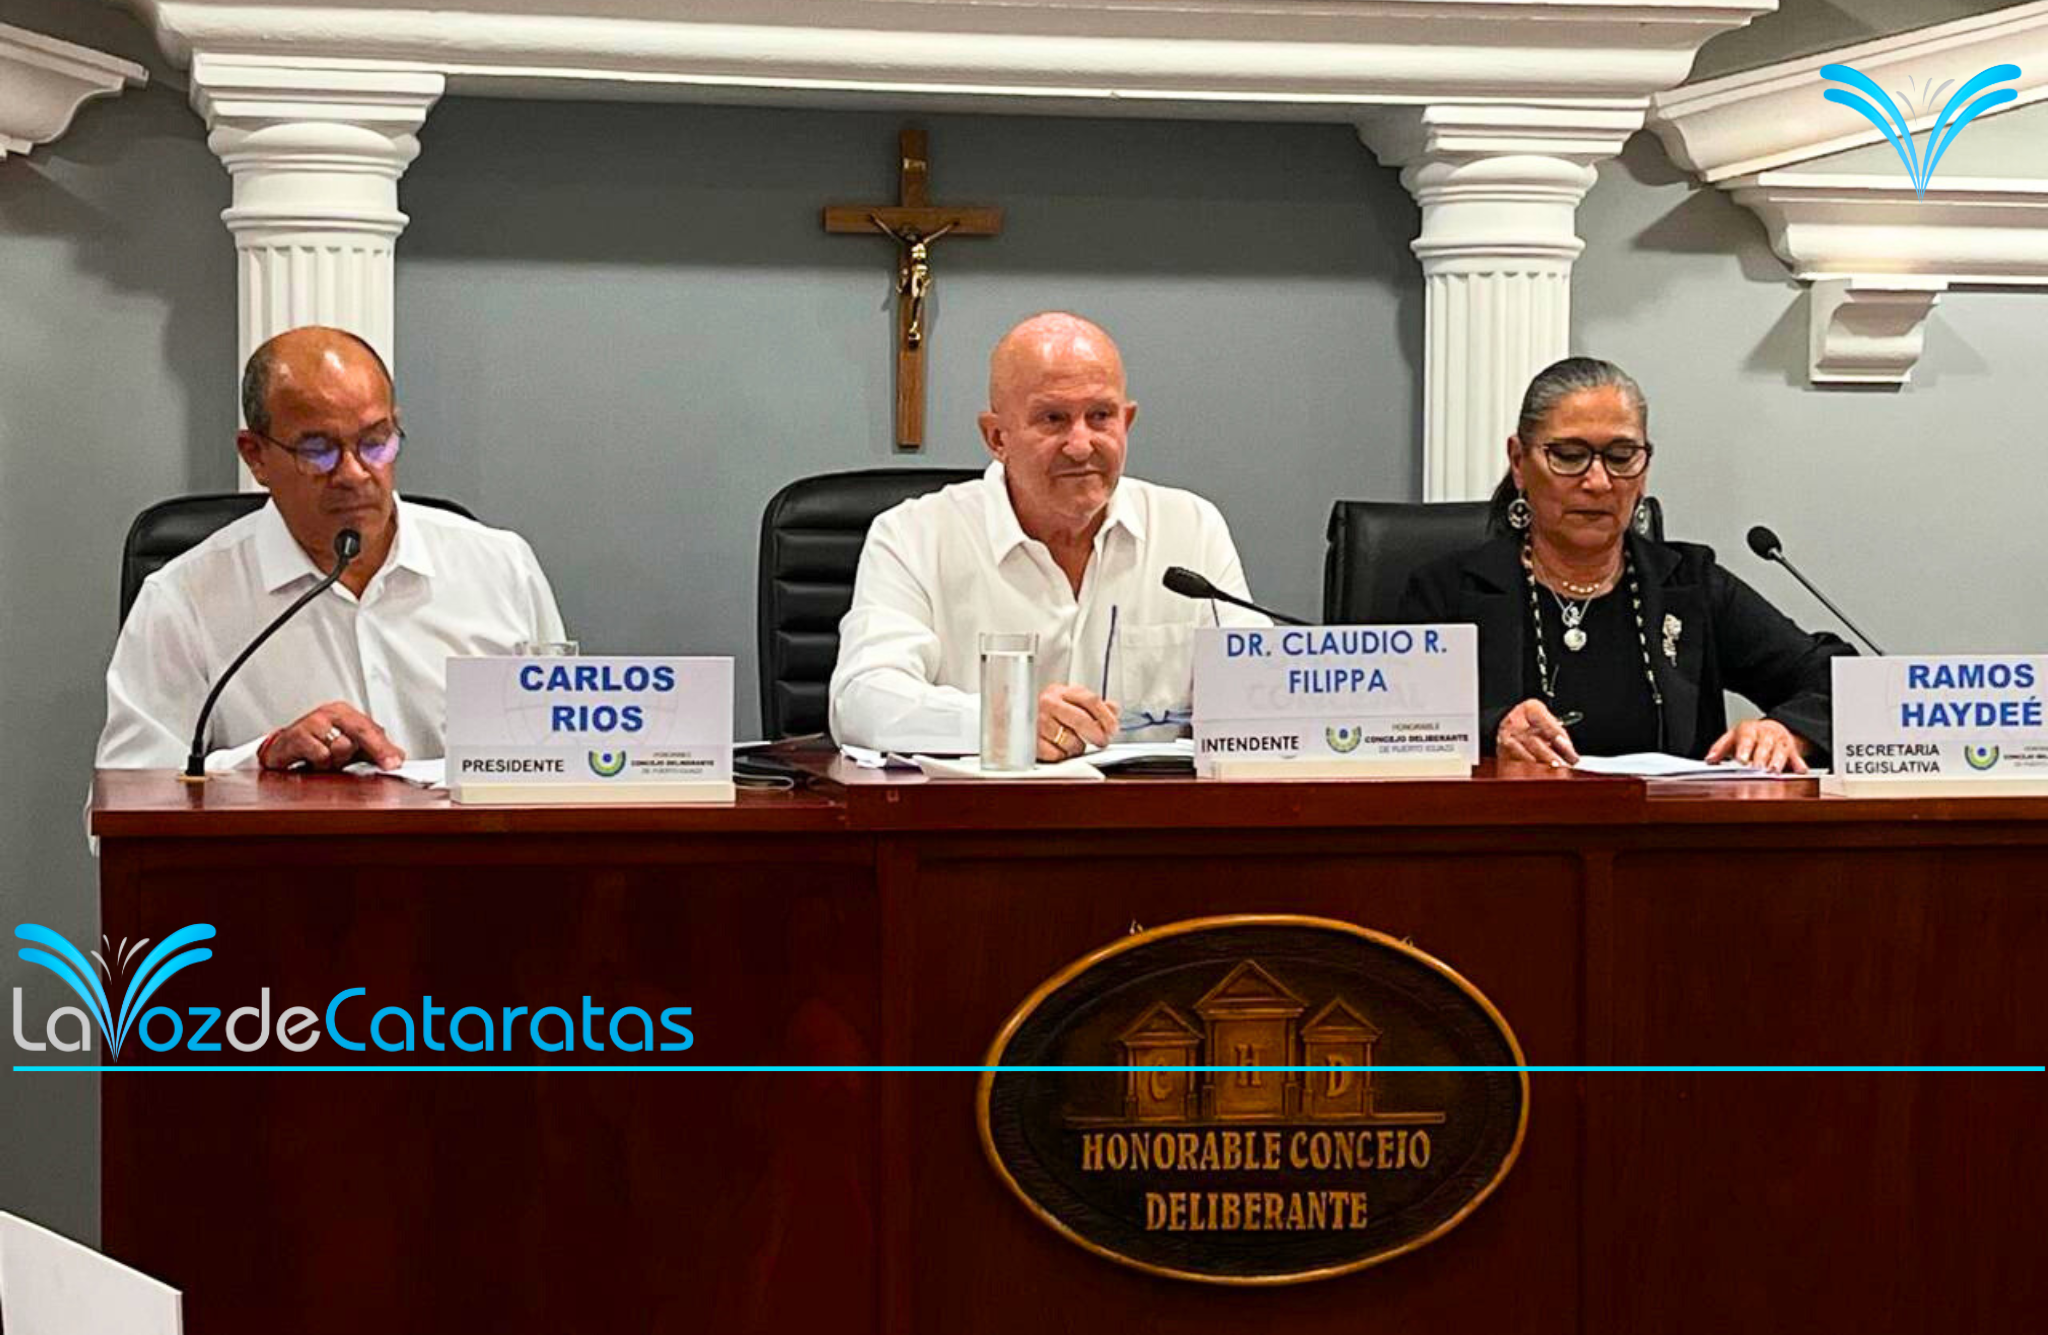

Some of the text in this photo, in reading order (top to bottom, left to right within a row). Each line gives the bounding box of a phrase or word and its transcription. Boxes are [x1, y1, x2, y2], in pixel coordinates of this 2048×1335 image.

[1227, 630, 1447, 657] DR. CLAUDIO R.
[519, 664, 675, 692] CARLOS
[1289, 669, 1388, 694] FILIPPA
[1908, 664, 2035, 689] RAMOS
[551, 705, 643, 732] RIOS
[1901, 695, 2043, 727] HAYDEÉ
[1201, 735, 1300, 752] INTENDENTE
[1364, 734, 1469, 743] CONCEJO DELIBERANTE
[1845, 744, 1940, 757] SECRETARIA
[462, 759, 565, 773] PRESIDENTE
[1845, 761, 1940, 774] LEGISLATIVA
[1234, 1043, 1263, 1087] H
[1326, 1053, 1351, 1098] D
[1082, 1129, 1431, 1170] HONORABLE CONCEJO
[1145, 1191, 1368, 1231] DELIBERANTE
